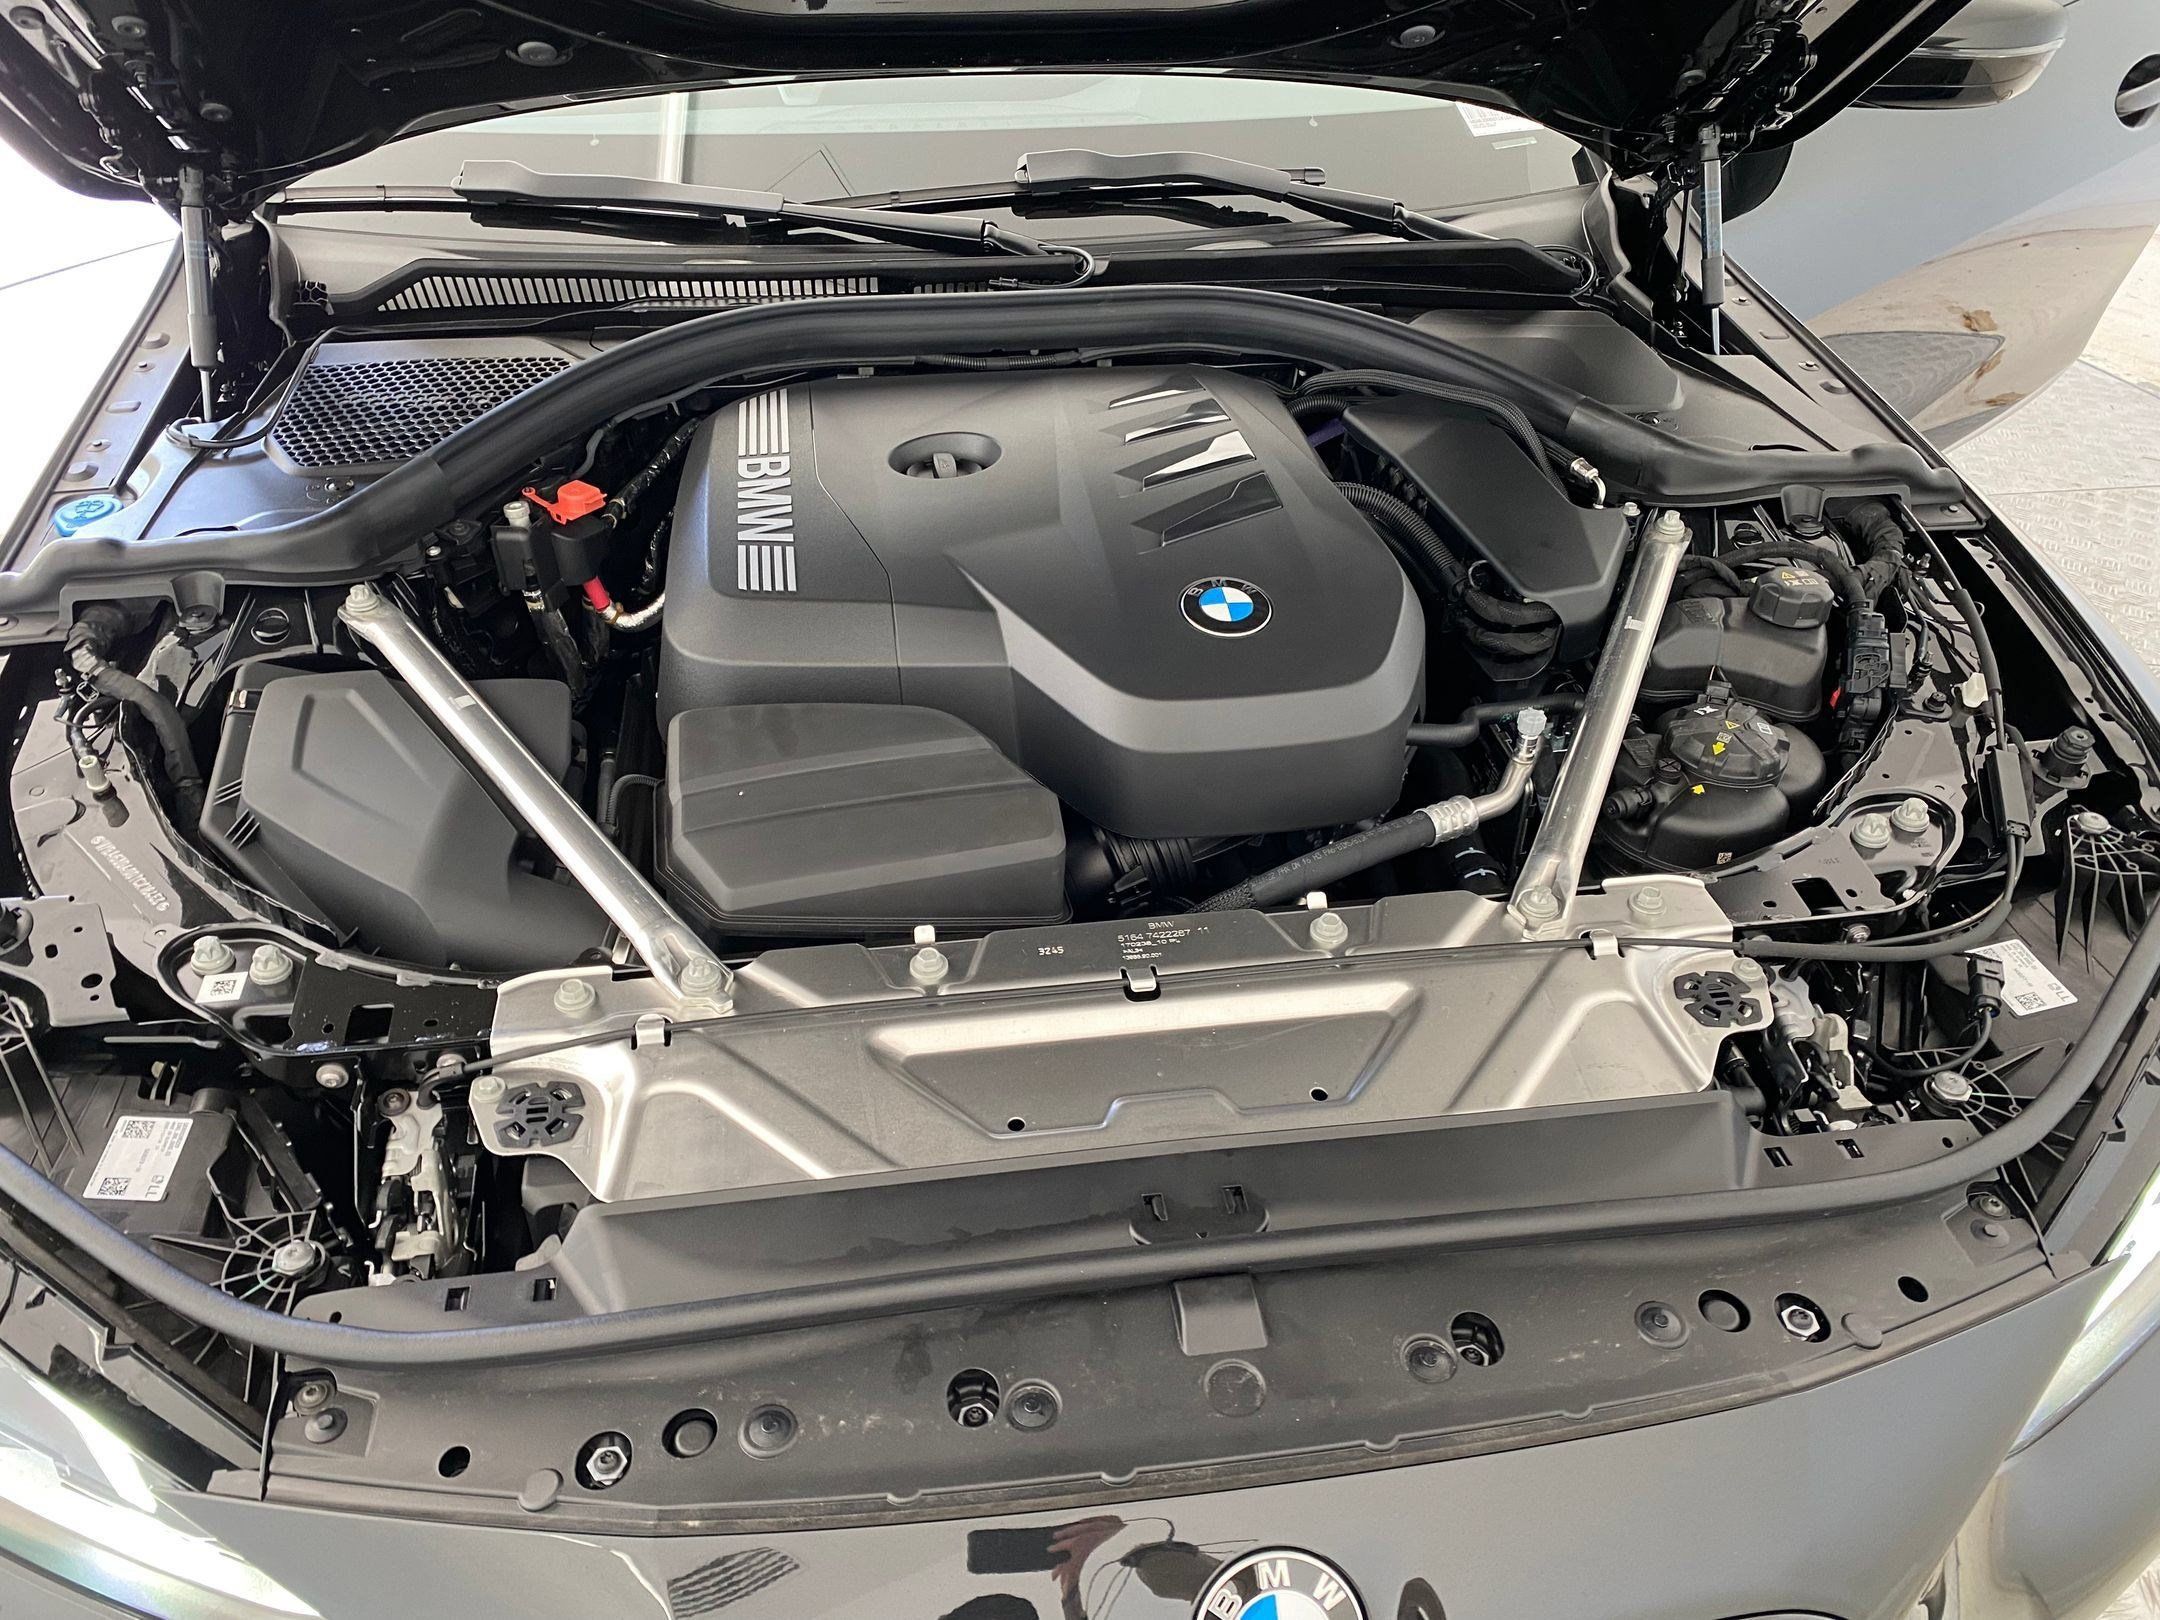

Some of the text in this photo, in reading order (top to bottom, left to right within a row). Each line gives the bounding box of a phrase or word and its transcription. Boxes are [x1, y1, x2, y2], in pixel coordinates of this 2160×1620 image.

[738, 455, 794, 542] BMW
[1187, 578, 1258, 597] BMW
[1148, 920, 1175, 930] BMW
[1117, 932, 1144, 943] 5164
[1197, 926, 1210, 936] 11
[1038, 945, 1065, 956] 3245
[1207, 1559, 1347, 1620] BMW
